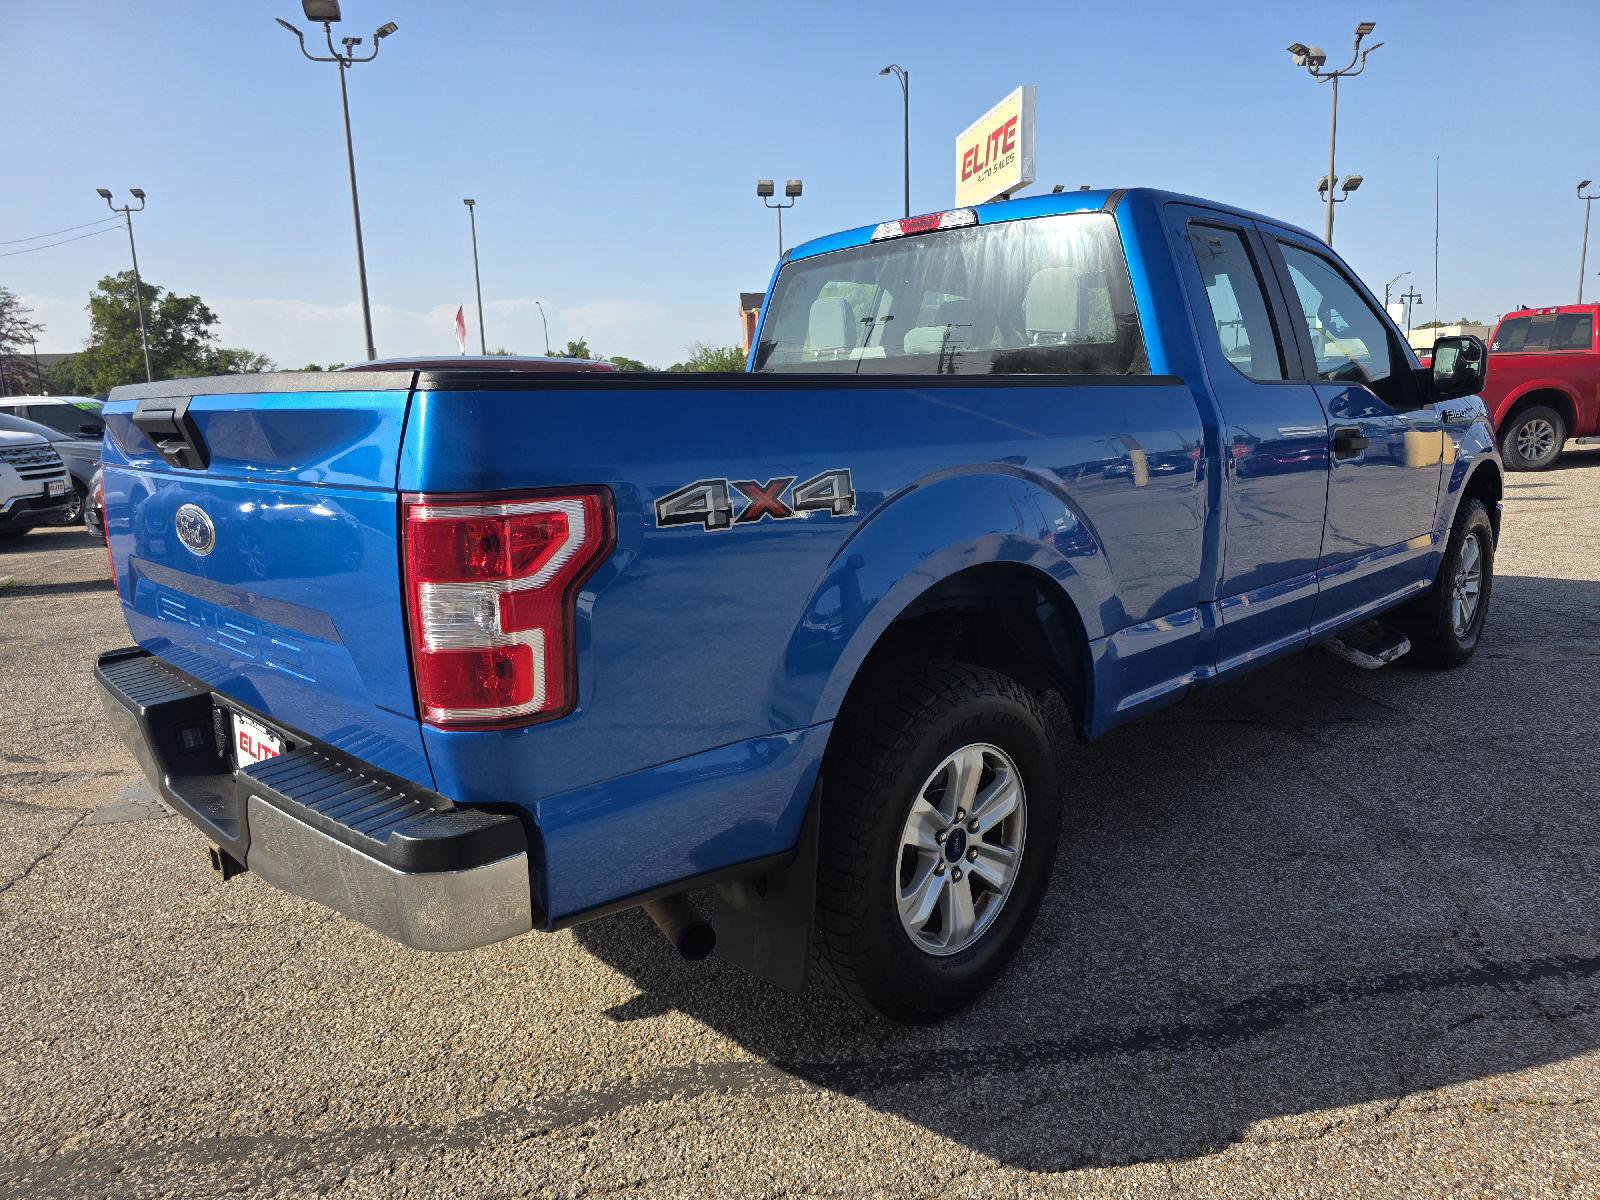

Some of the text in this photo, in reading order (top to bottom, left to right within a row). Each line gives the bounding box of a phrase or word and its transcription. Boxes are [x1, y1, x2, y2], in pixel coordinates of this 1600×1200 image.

[962, 114, 1018, 182] ELITE
[977, 152, 1015, 182] AUTO SALES
